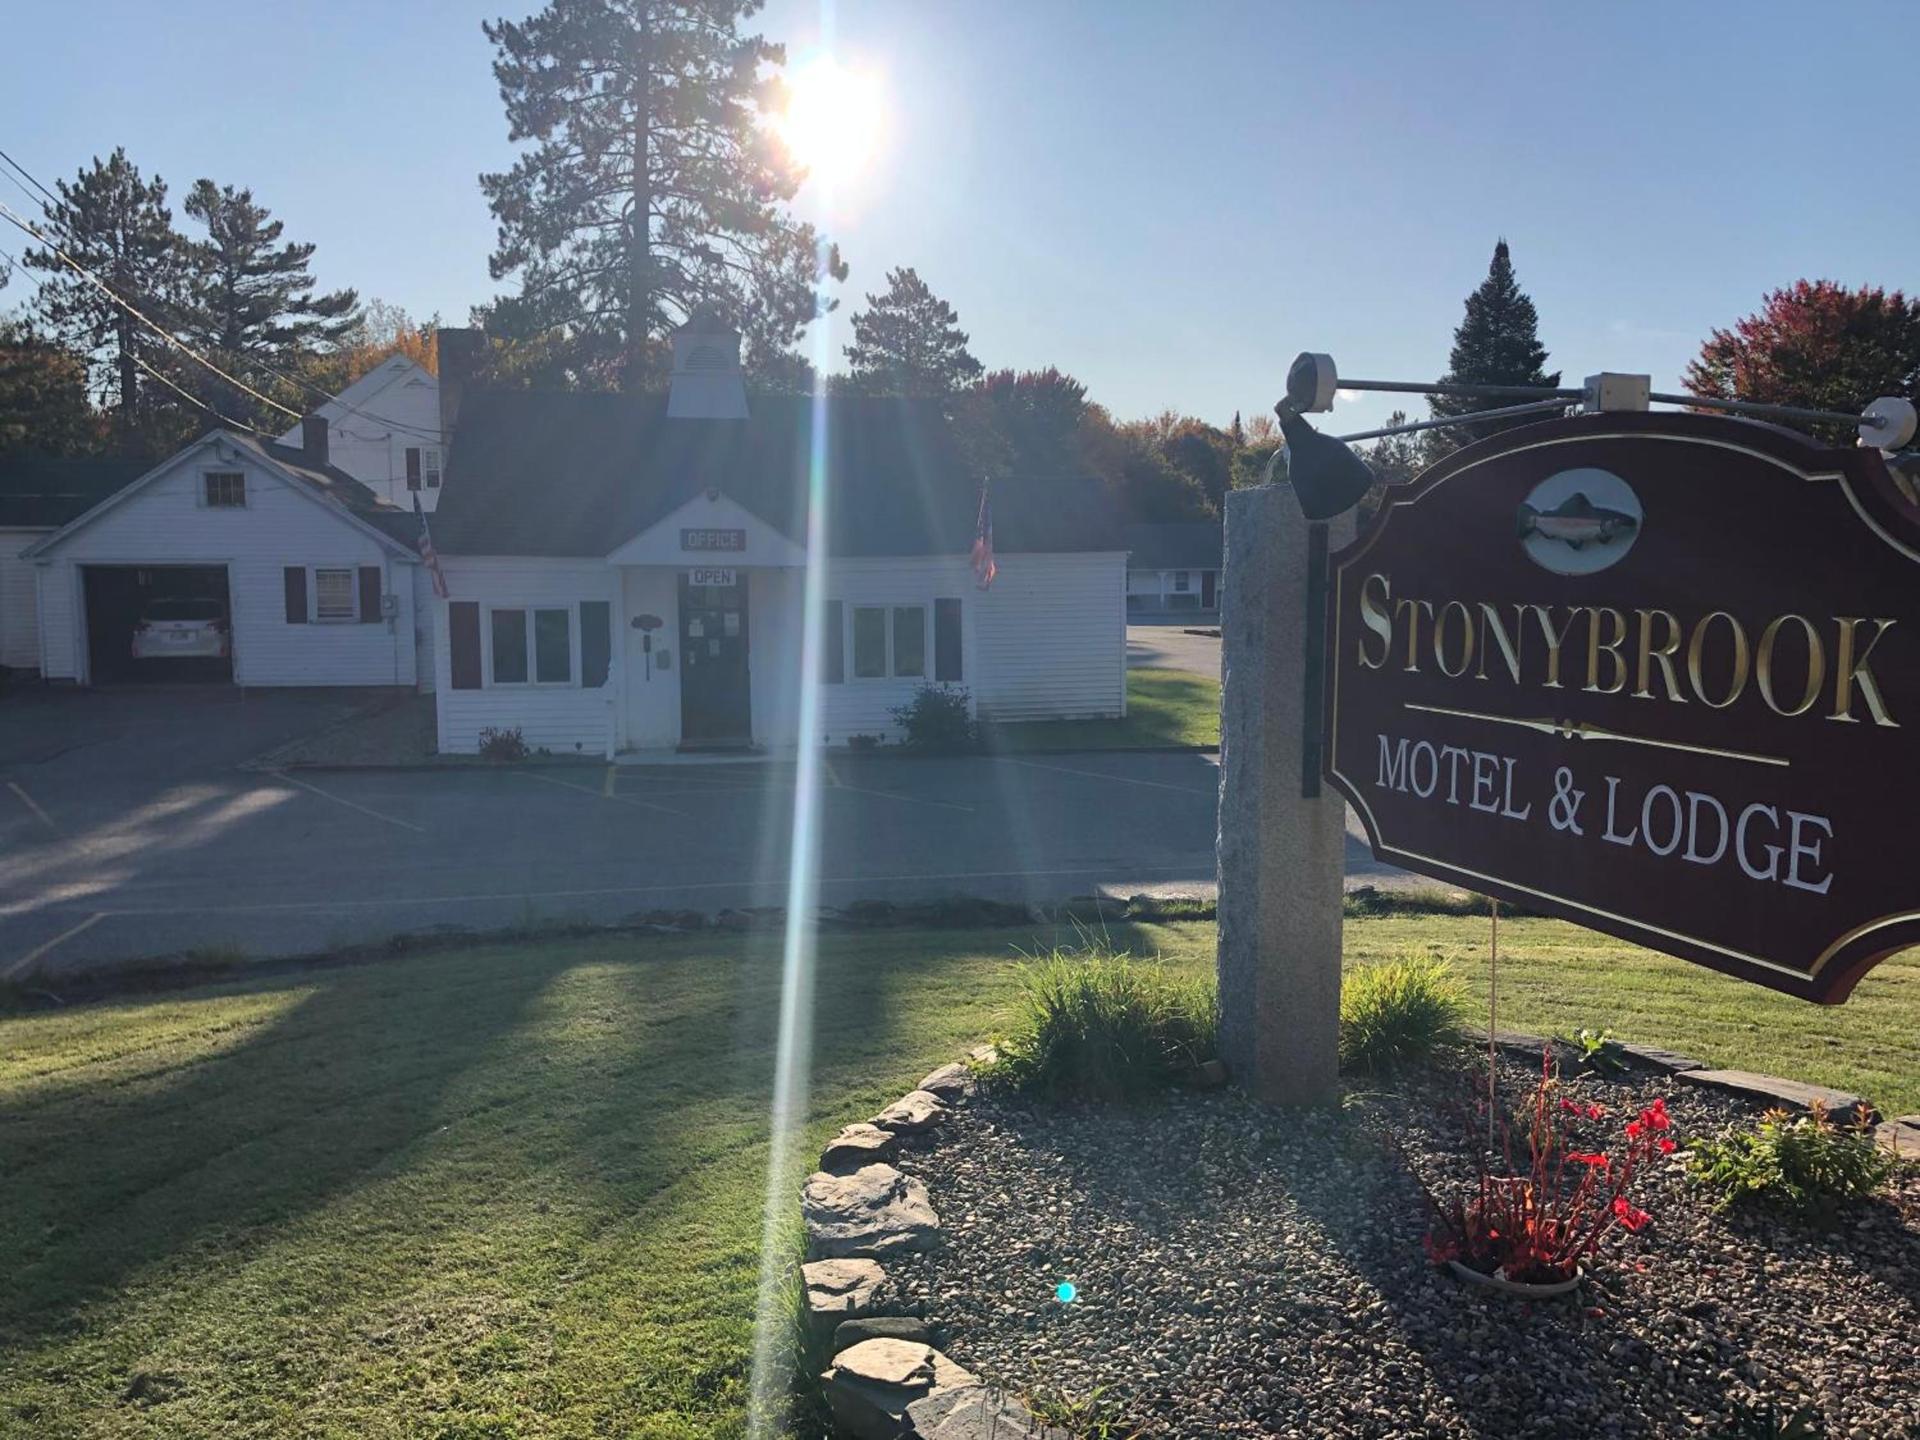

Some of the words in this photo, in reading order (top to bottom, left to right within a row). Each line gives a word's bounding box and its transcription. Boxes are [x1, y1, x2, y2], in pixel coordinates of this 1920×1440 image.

[688, 532, 738, 548] OFFICE
[694, 569, 731, 584] OPEN
[1358, 573, 1901, 728] STONYBROOK
[1375, 735, 1532, 821] MOTEL
[1548, 766, 1586, 836] &
[1602, 776, 1836, 895] LODGE
